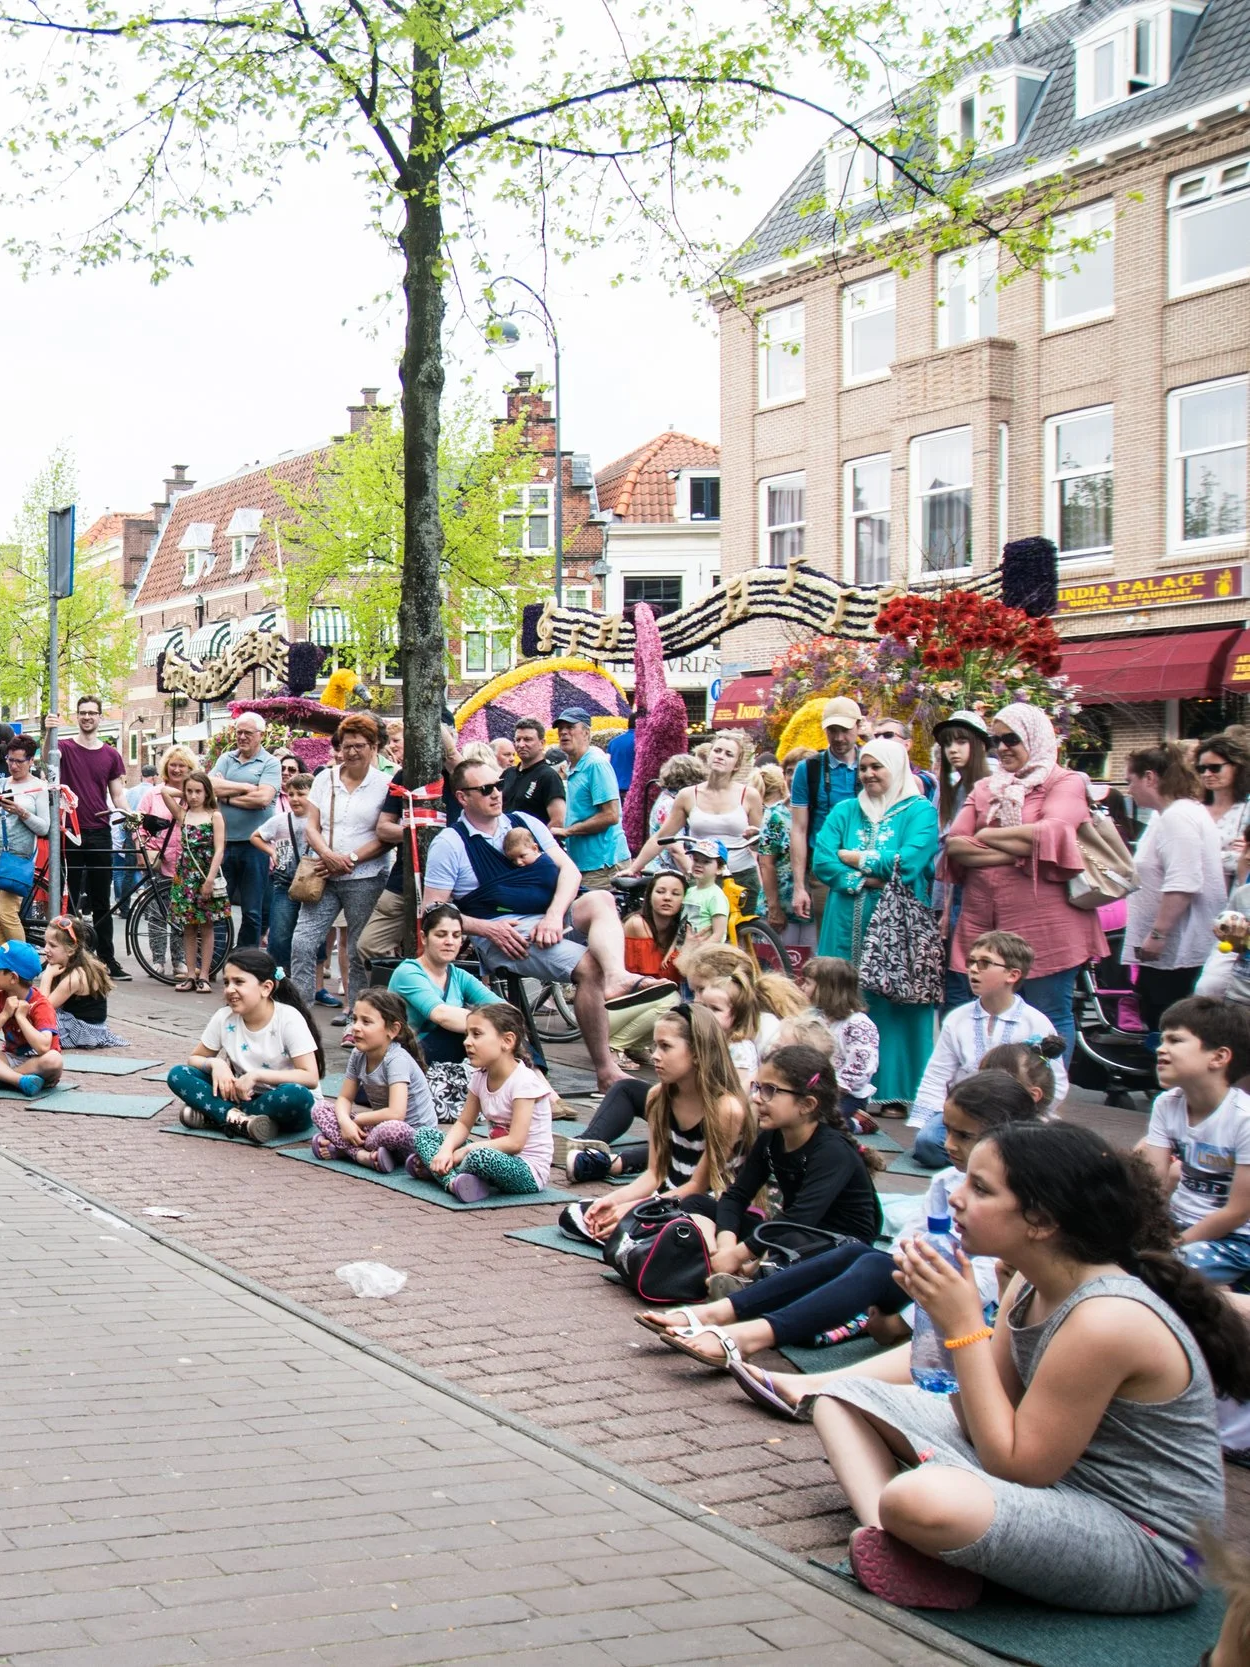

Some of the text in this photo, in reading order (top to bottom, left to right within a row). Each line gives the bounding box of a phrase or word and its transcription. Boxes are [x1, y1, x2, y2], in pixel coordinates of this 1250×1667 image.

[1059, 573, 1206, 601] INDIA PALACE
[1069, 597, 1108, 607] INDIAN
[1111, 588, 1192, 602] RESTAURANT
